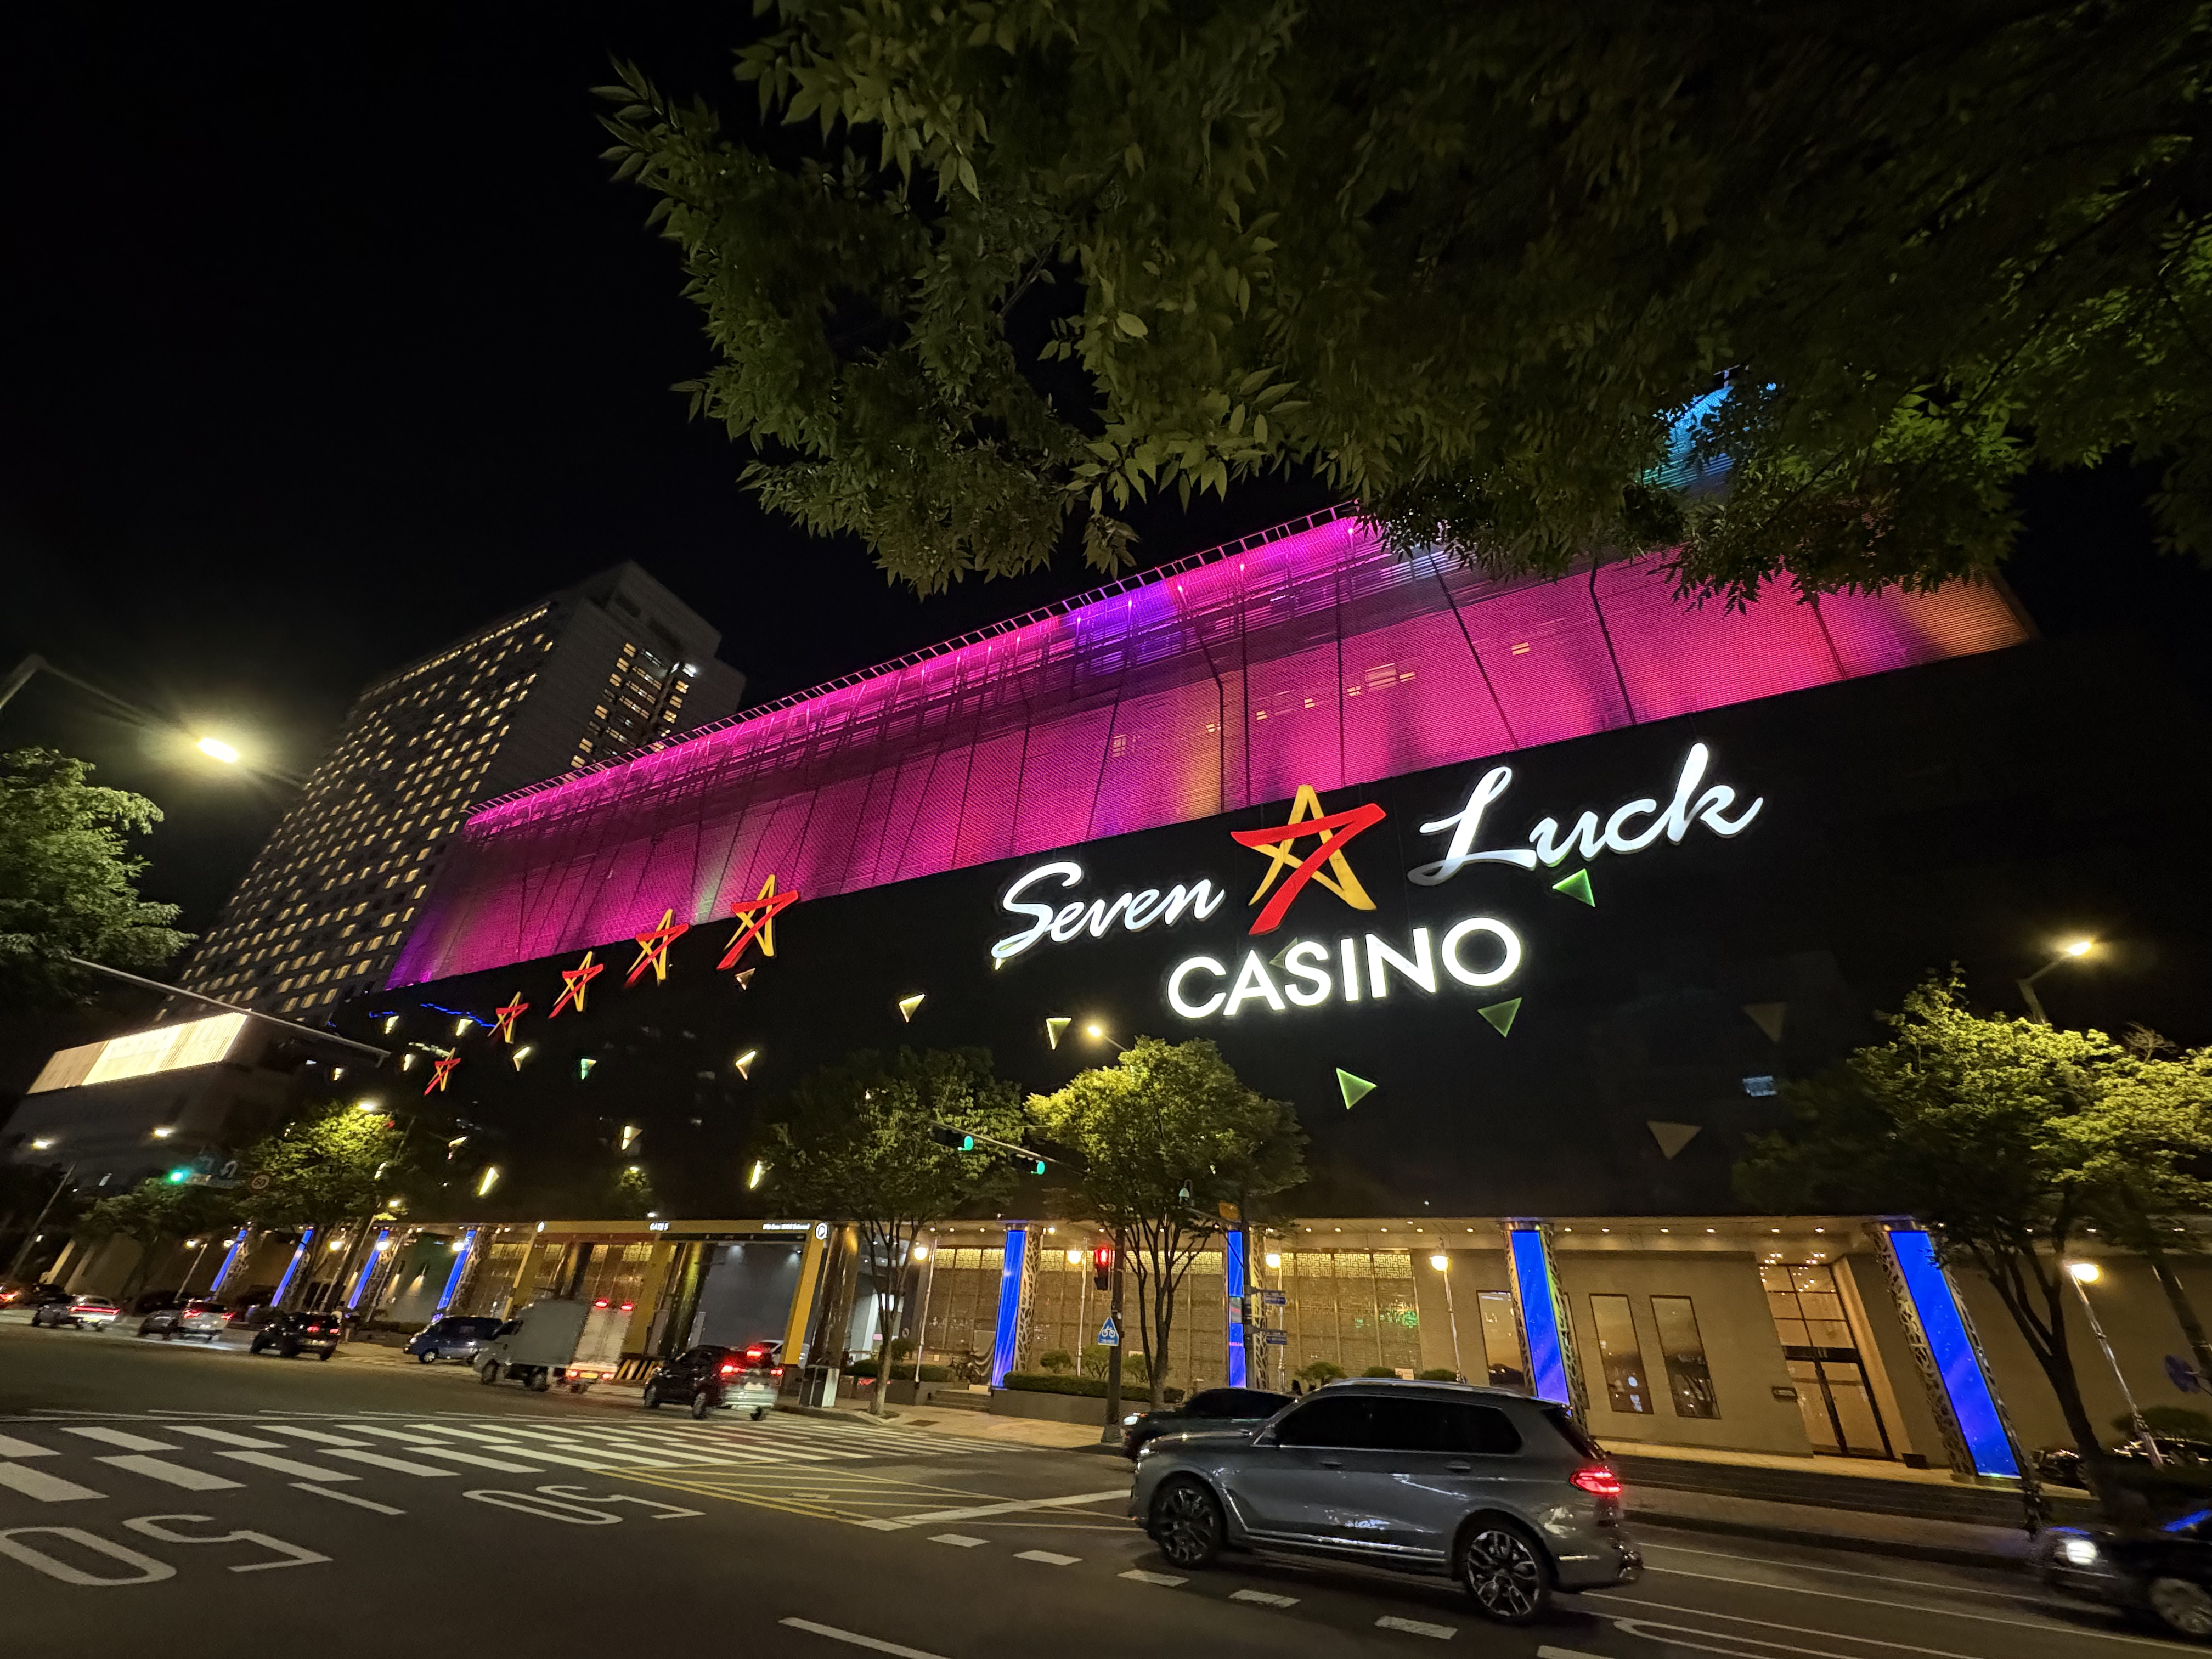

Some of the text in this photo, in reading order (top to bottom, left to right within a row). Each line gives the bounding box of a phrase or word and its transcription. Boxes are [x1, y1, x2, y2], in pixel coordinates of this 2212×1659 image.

[991, 742, 1763, 959] Seven Luck
[1167, 916, 1522, 1019] CASINO
[462, 1485, 707, 1525] 50
[0, 1514, 334, 1587] 50
